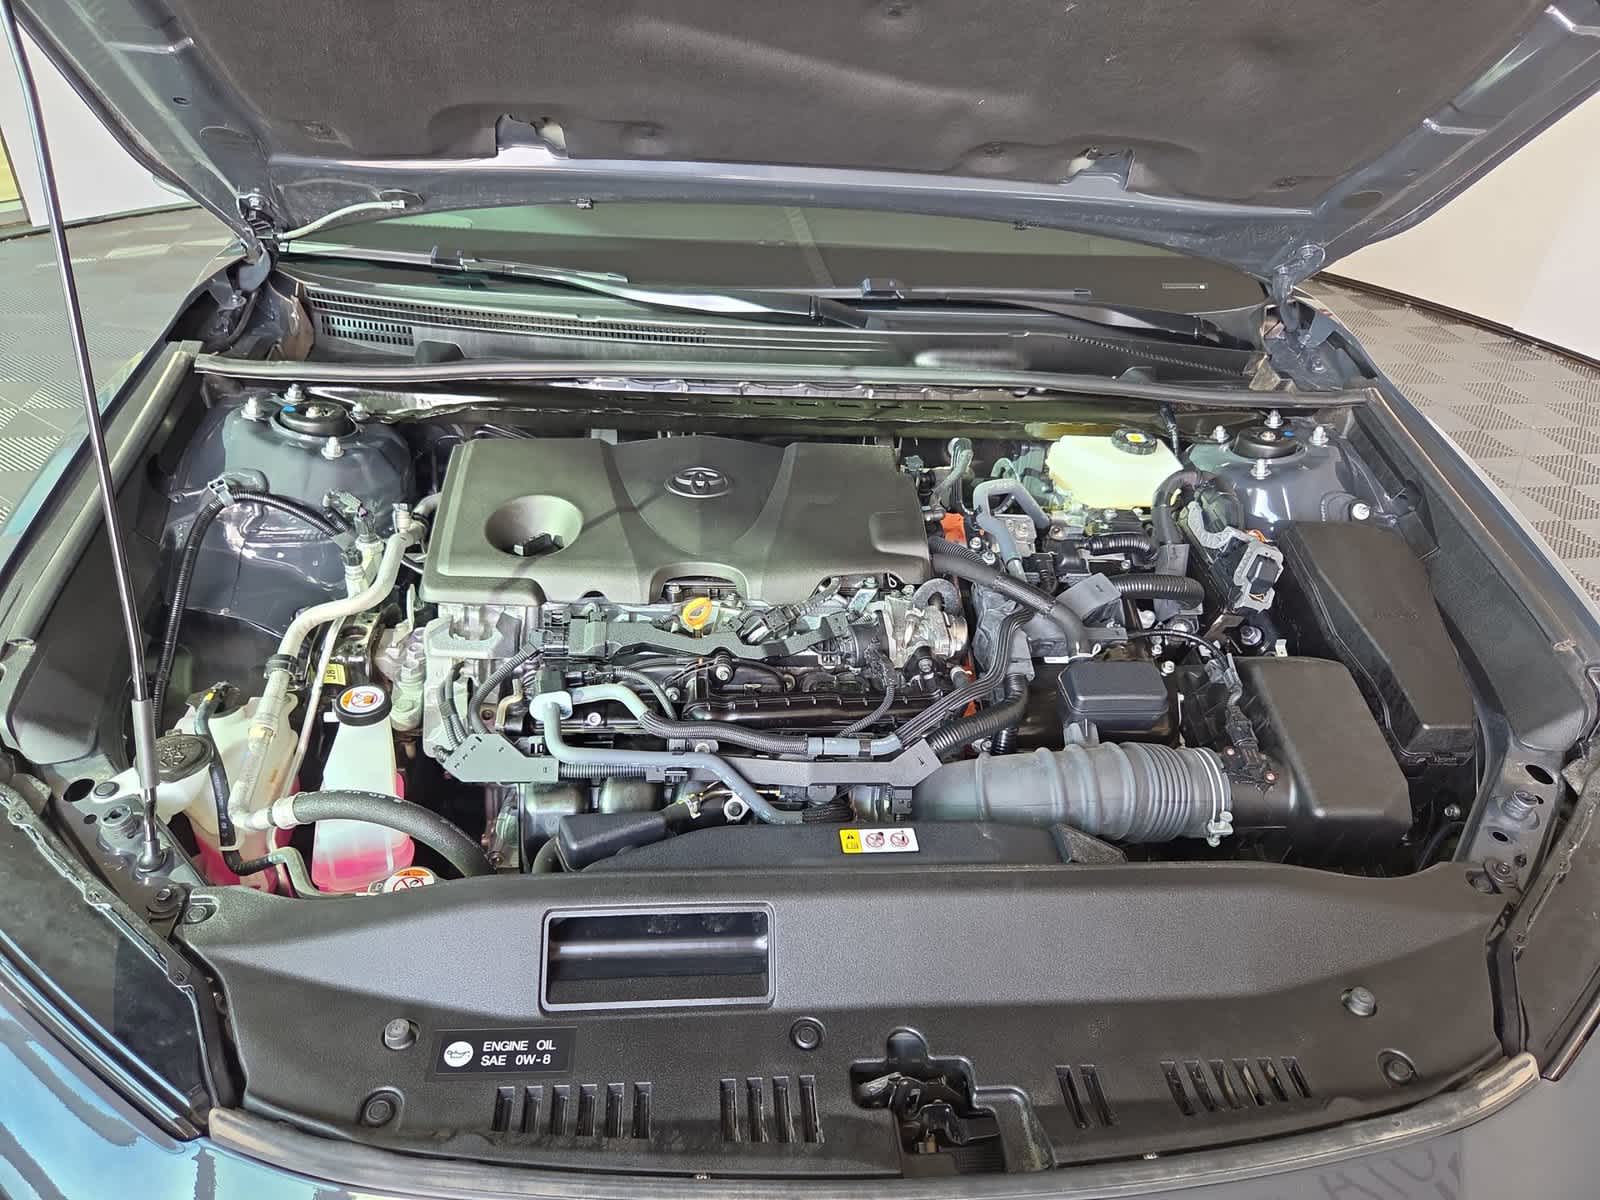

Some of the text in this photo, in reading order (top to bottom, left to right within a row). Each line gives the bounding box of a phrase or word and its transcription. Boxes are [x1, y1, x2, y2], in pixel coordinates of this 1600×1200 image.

[482, 1039, 557, 1052] ENGINE OIL
[480, 1054, 551, 1066] SAE 0W-8
